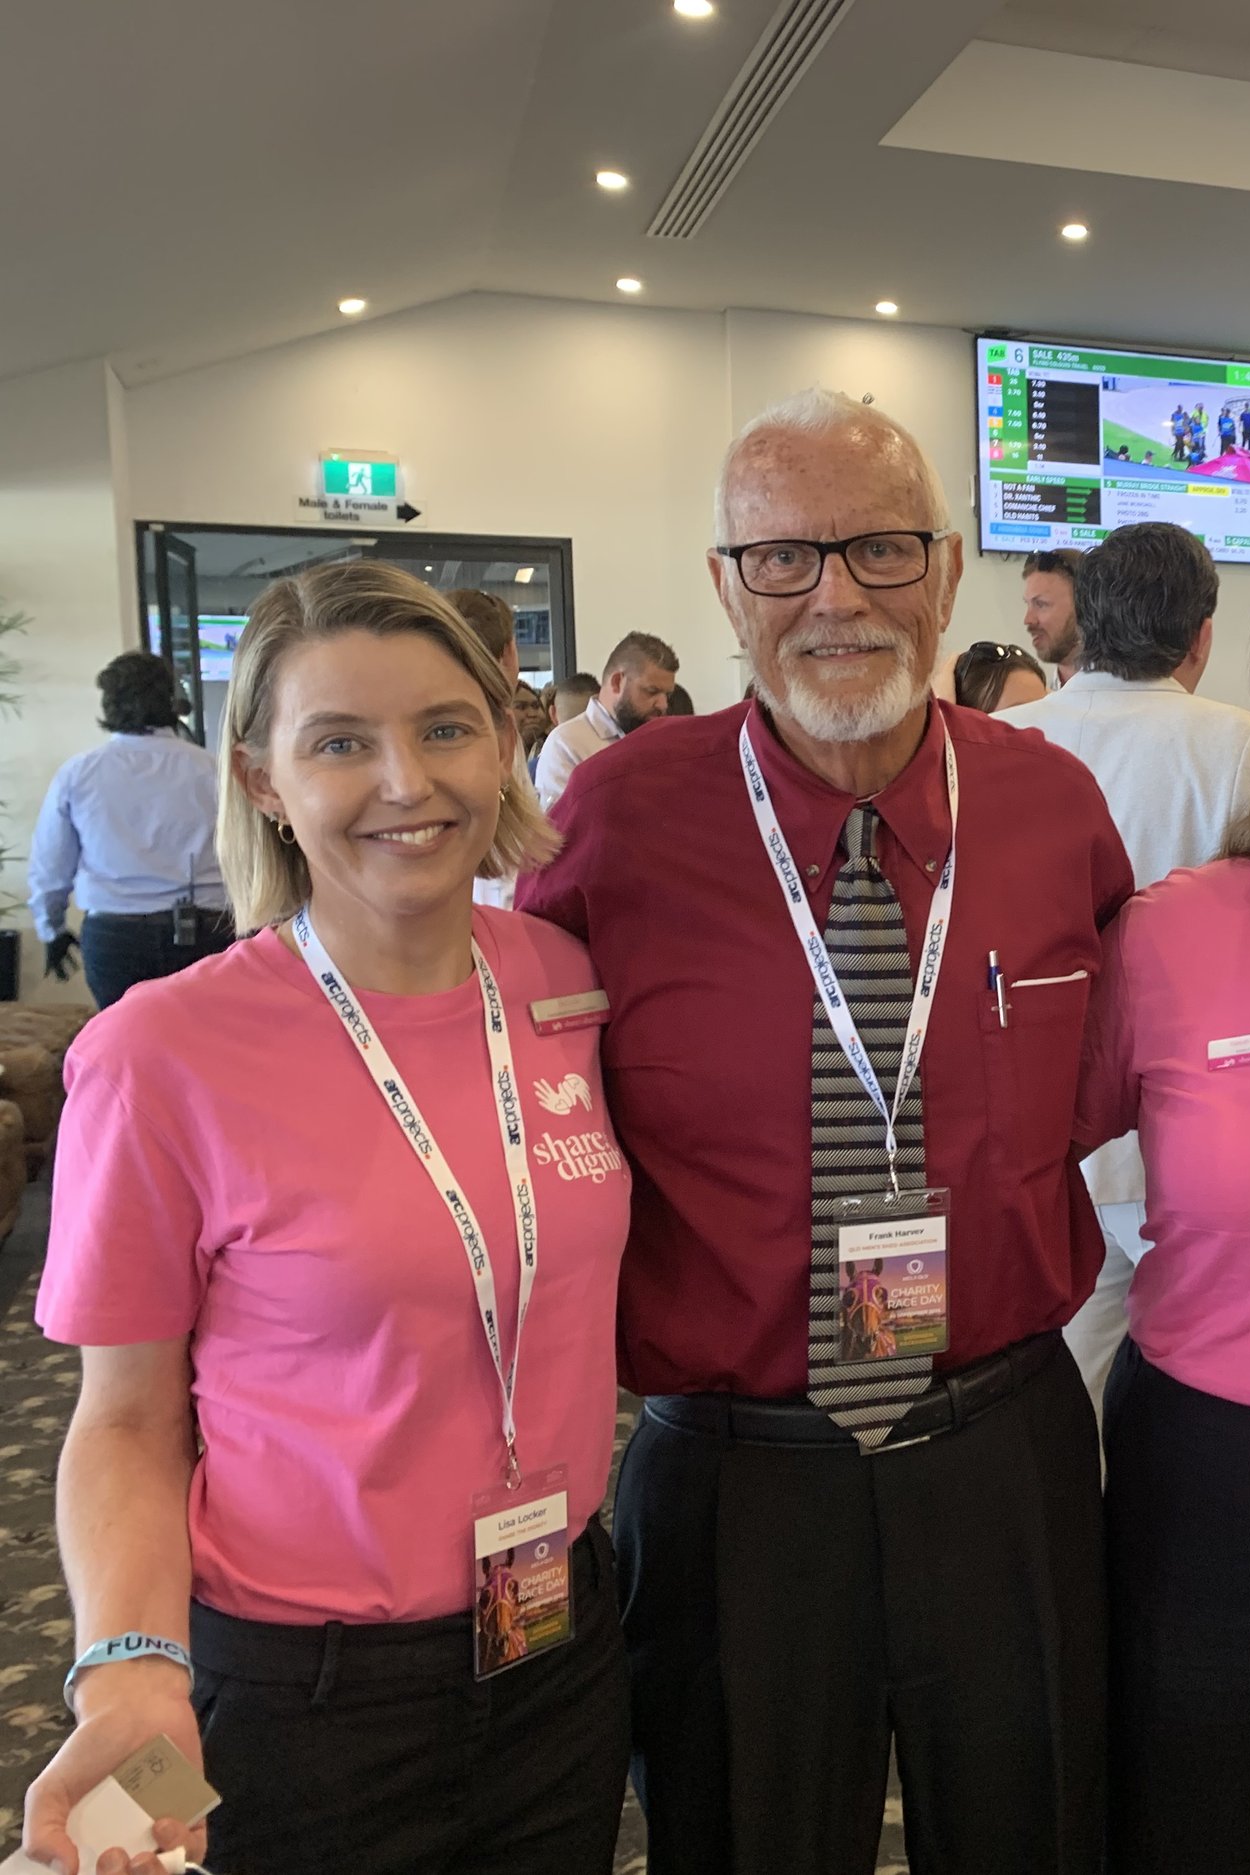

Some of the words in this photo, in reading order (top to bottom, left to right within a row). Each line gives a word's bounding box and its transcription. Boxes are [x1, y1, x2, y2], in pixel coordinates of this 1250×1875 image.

[1014, 348, 1024, 363] 6
[1032, 349, 1053, 360] SALE
[298, 497, 327, 509] Male
[332, 499, 340, 509] &
[345, 499, 388, 511] Female
[324, 510, 360, 521] toilets
[532, 1131, 606, 1165] share
[869, 1231, 893, 1240] Frank
[895, 1228, 925, 1238] Harvey
[891, 1283, 941, 1298] CHARITY
[887, 1296, 918, 1310] RACE
[920, 1293, 944, 1305] DAY
[498, 1519, 515, 1531] Lisa
[518, 1508, 547, 1524] Locker
[521, 1565, 563, 1589] CHARITY
[518, 1585, 544, 1603] RACE
[546, 1576, 566, 1592] DAY
